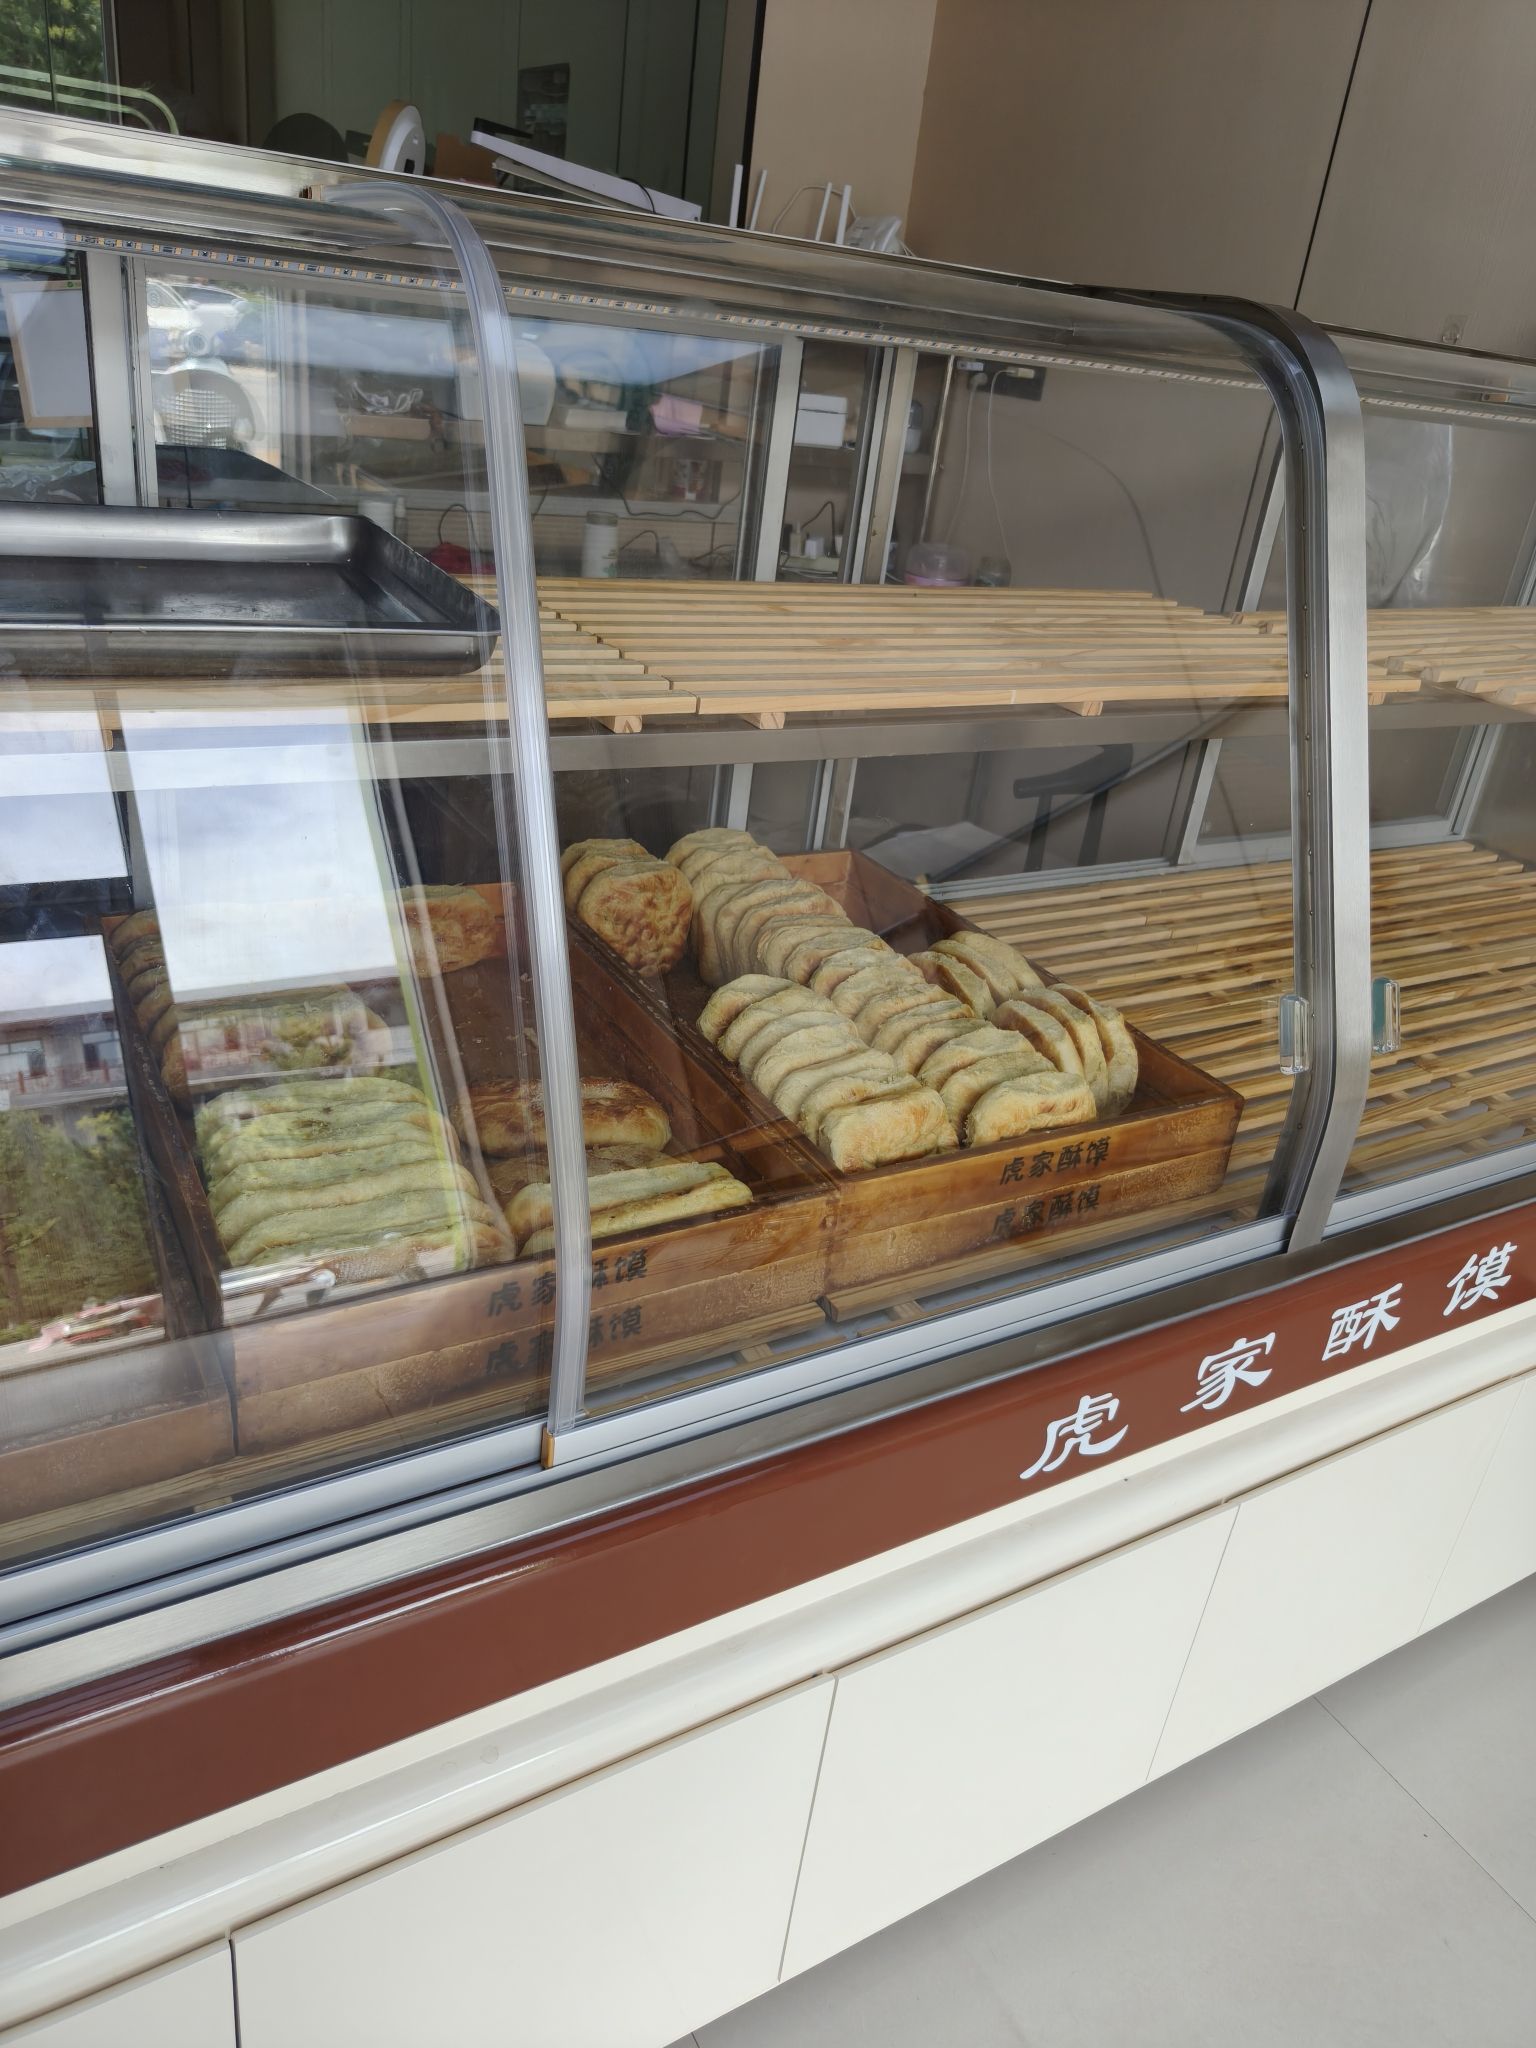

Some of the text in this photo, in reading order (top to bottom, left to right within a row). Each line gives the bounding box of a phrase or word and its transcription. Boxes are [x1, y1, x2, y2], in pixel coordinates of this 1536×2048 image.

[1000, 1136, 1111, 1185] 虎家酥馍
[1019, 1241, 1518, 1480] 虎家酥馍
